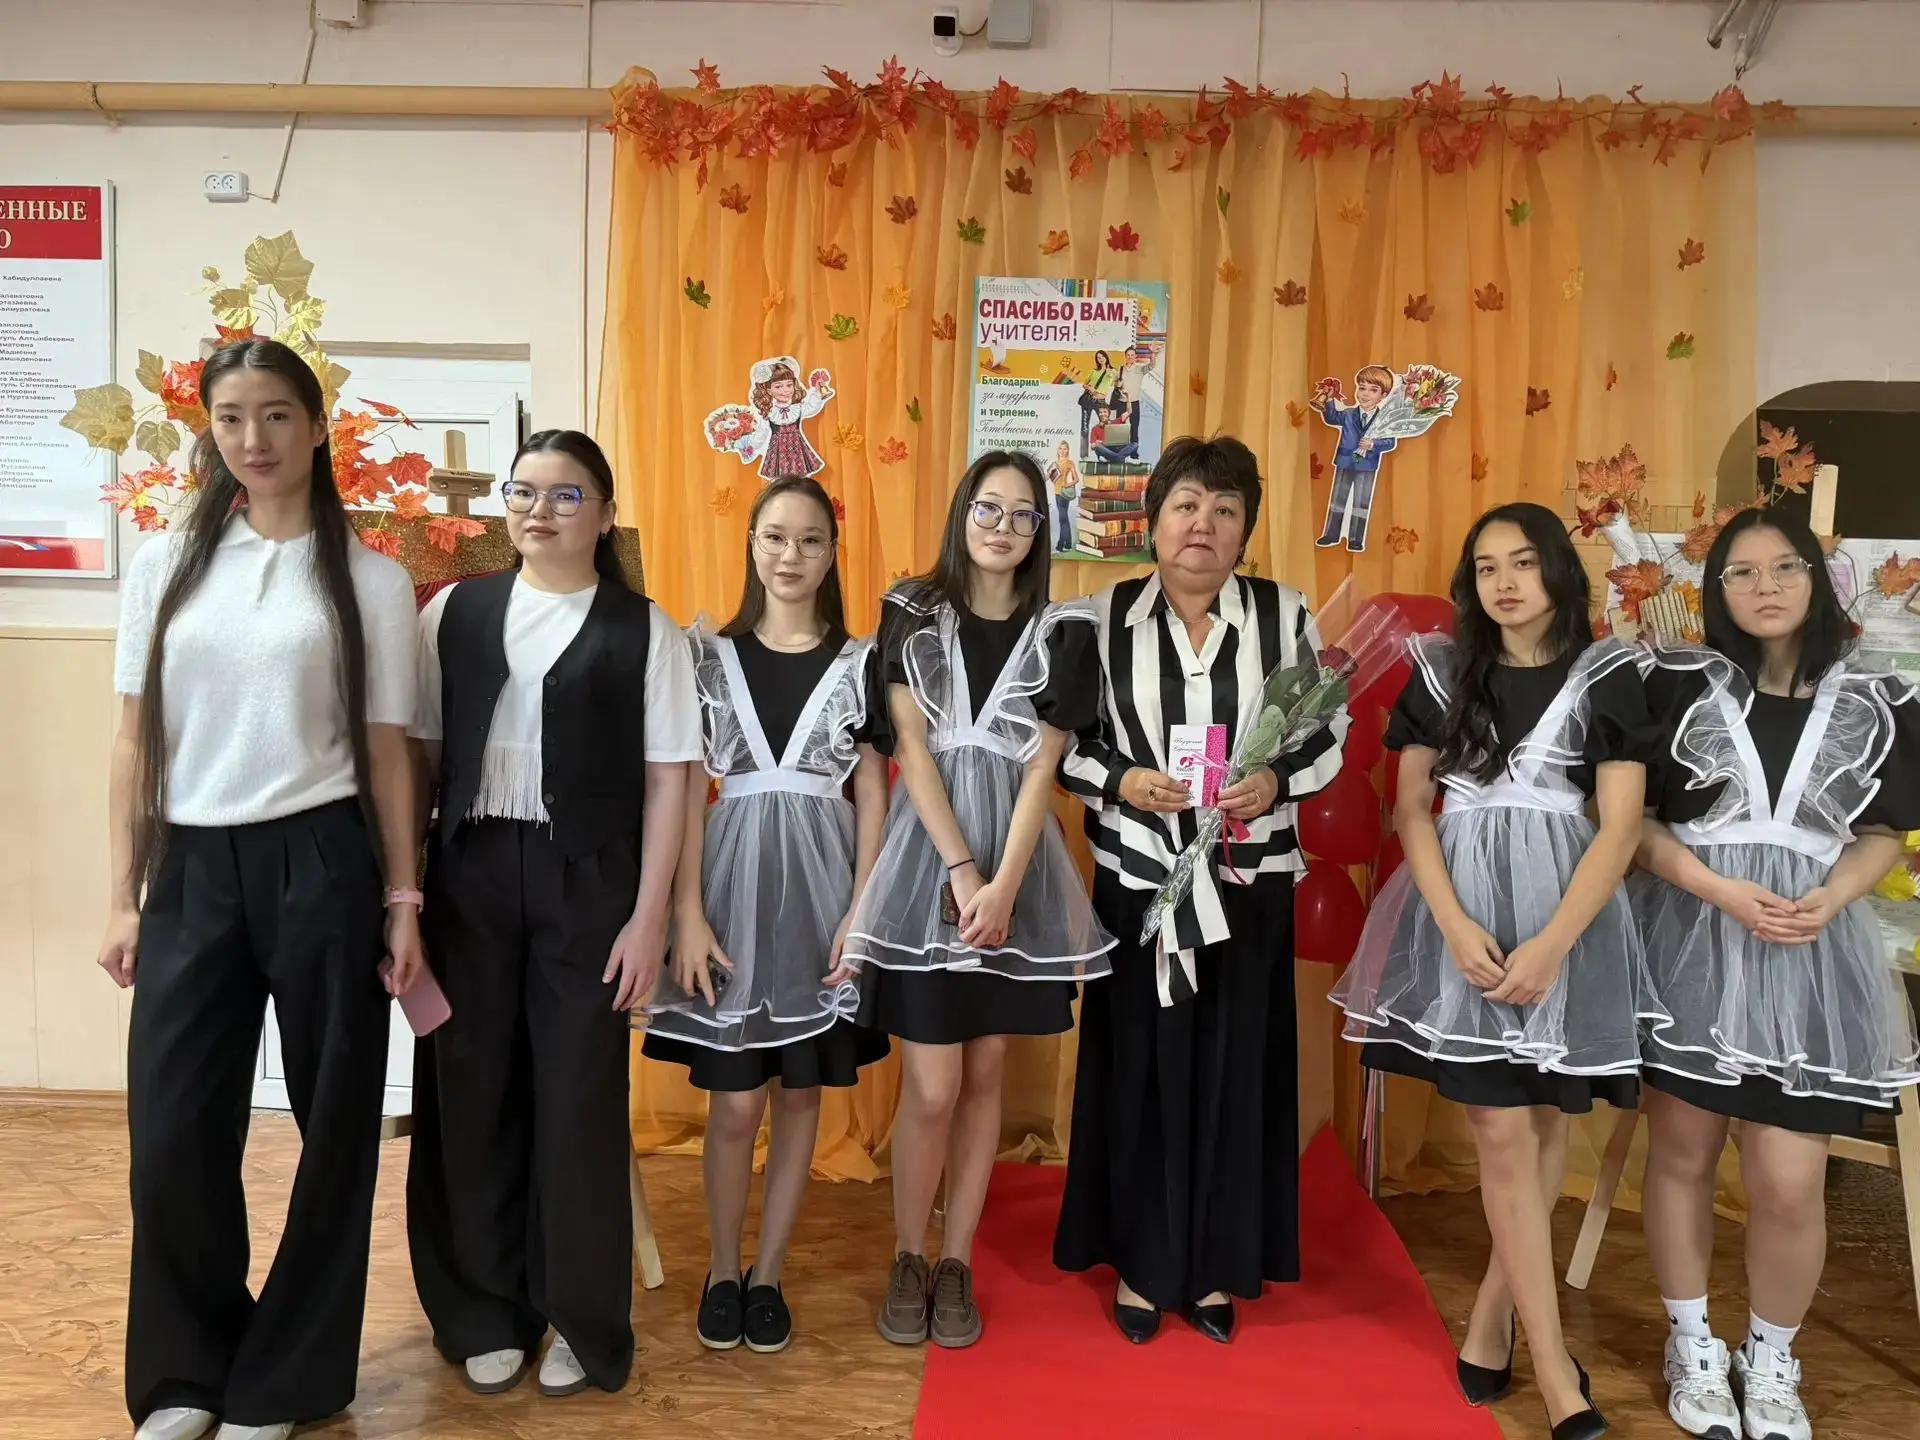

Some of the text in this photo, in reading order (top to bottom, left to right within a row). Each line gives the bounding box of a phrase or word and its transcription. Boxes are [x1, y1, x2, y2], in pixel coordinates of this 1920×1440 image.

[979, 299, 1129, 325] СПАСИБО ВАМ,
[980, 320, 1077, 343] учителя!
[982, 375, 1040, 388] Благодарим
[980, 390, 1051, 406] за мудрость
[989, 408, 1038, 419] терпение,
[1035, 427, 1042, 435] и
[980, 438, 1050, 449] и поддержать!
